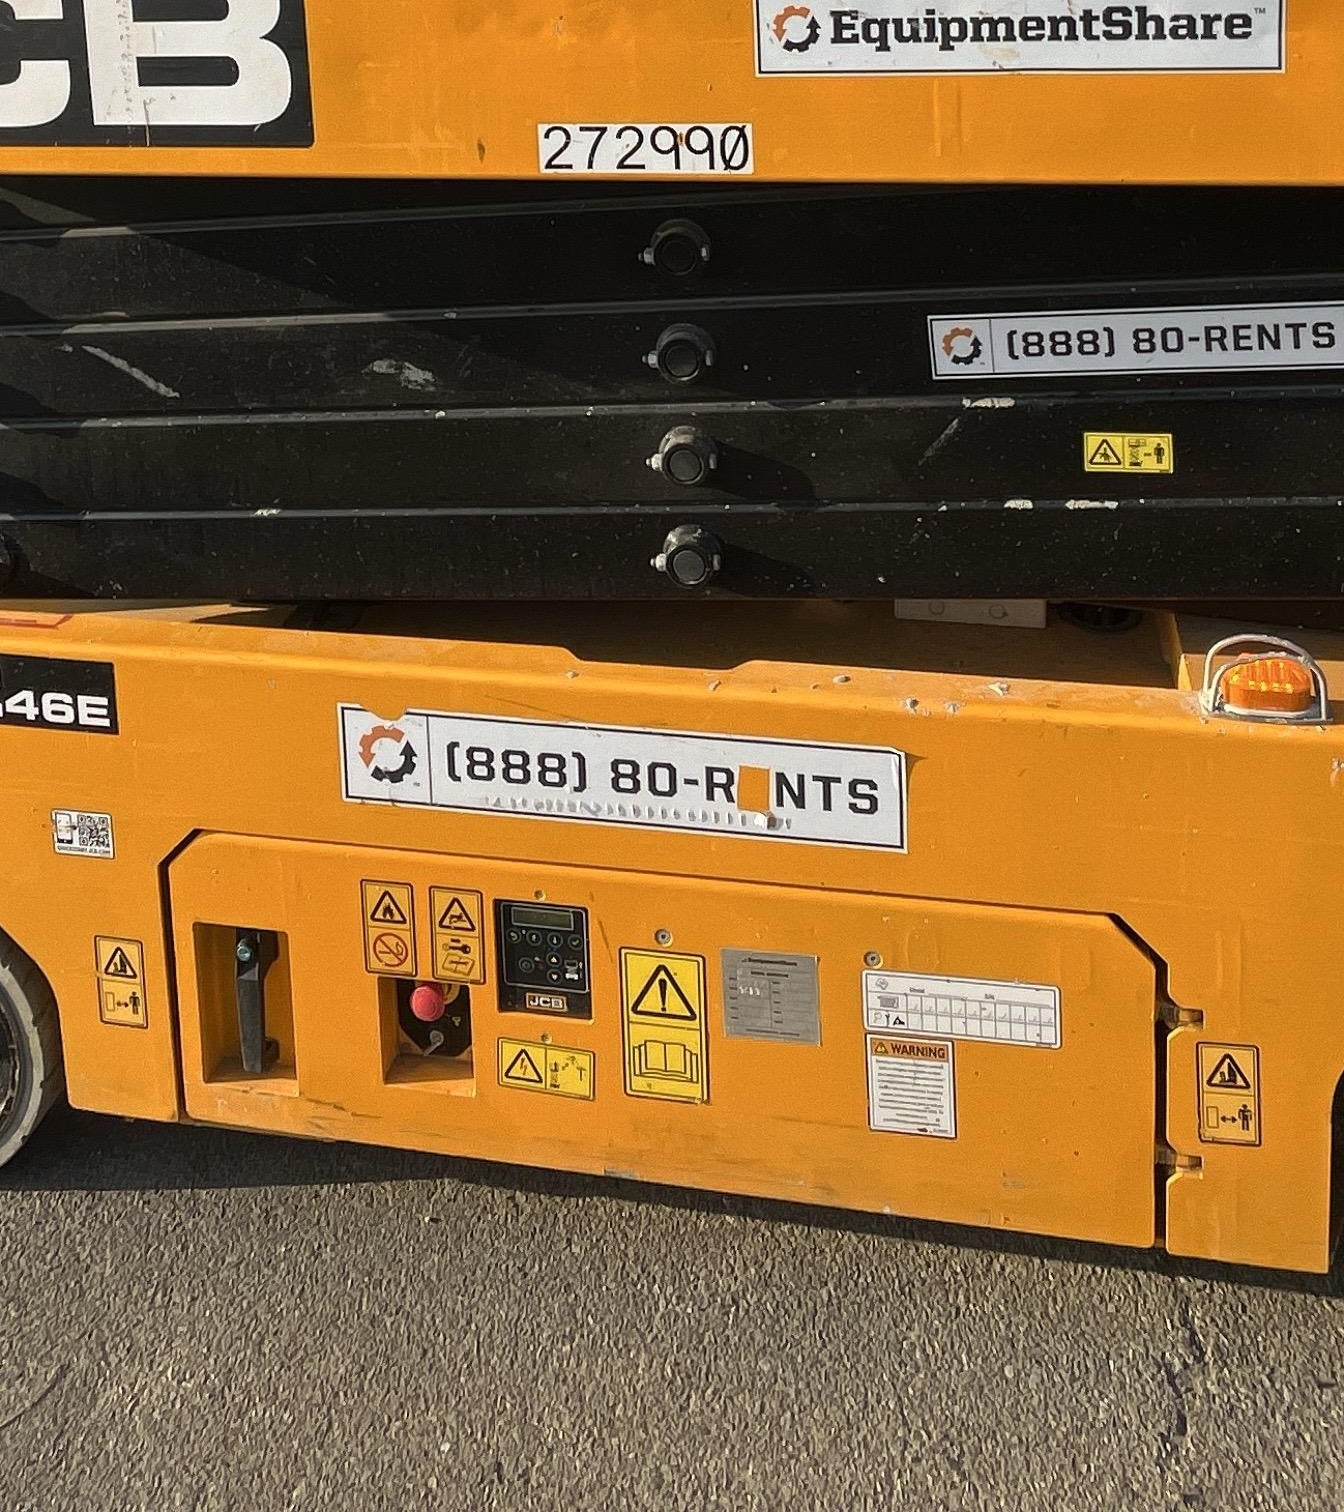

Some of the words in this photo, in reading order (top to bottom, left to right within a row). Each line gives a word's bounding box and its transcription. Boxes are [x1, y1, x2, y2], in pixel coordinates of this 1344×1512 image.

[830, 4, 1253, 52] EquipmentShare
[543, 124, 750, 172] 272990
[1006, 325, 1116, 361] (888)
[1132, 320, 1337, 355] 80-RENTS
[446, 740, 588, 794] (888)
[610, 758, 881, 817] 80-RNTS
[529, 996, 564, 1009] JCB
[889, 1042, 946, 1060] WARNING
